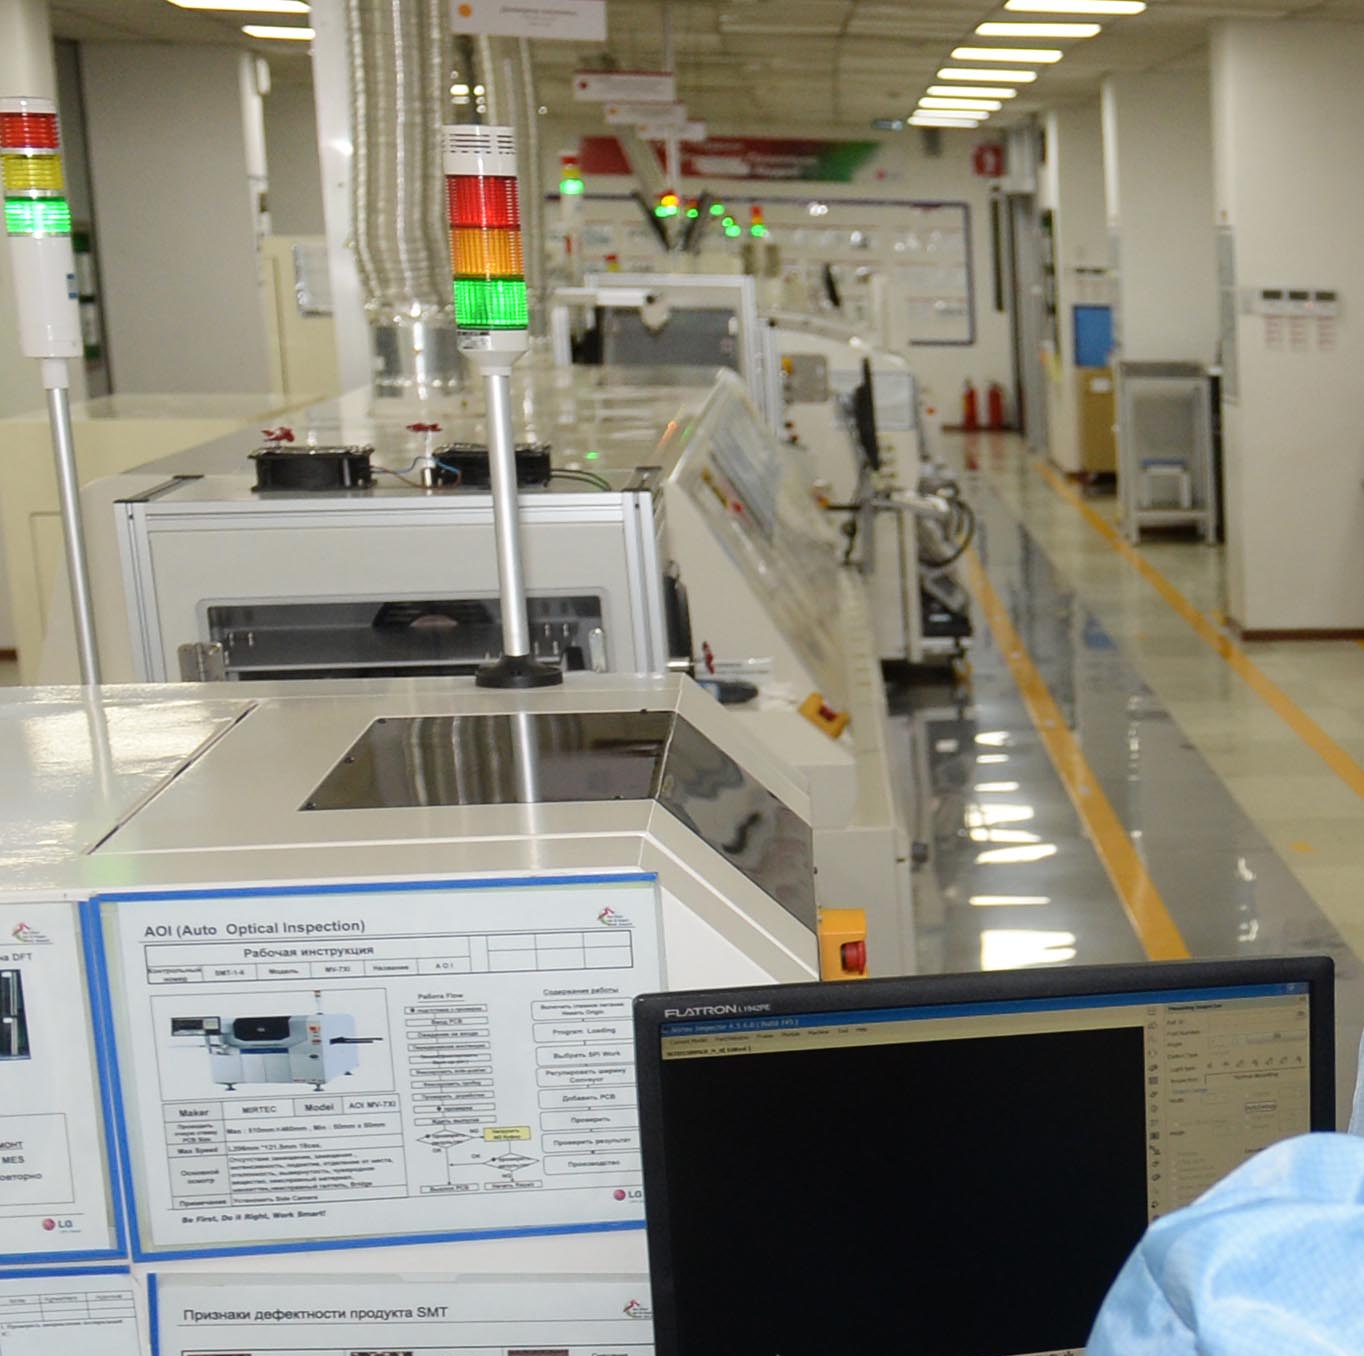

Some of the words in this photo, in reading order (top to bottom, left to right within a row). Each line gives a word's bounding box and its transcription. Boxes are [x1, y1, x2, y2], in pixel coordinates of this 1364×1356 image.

[144, 925, 172, 938] AOI
[176, 924, 217, 938] (Auto
[226, 922, 278, 936] Optical
[283, 920, 365, 934] Inspection)
[244, 948, 297, 958] Рабочая
[301, 946, 374, 958] инструкция
[12, 953, 32, 961] DFT
[664, 1005, 737, 1018] FLATRON
[305, 1103, 334, 1111] Model
[179, 1109, 209, 1117] Maker
[2, 1155, 25, 1164] MES
[58, 1219, 72, 1228] LG
[182, 1216, 194, 1224] Be
[184, 1309, 250, 1321] Признаки
[254, 1308, 346, 1321] дефектности
[350, 1308, 412, 1320] продукта
[417, 1306, 449, 1318] SMT
